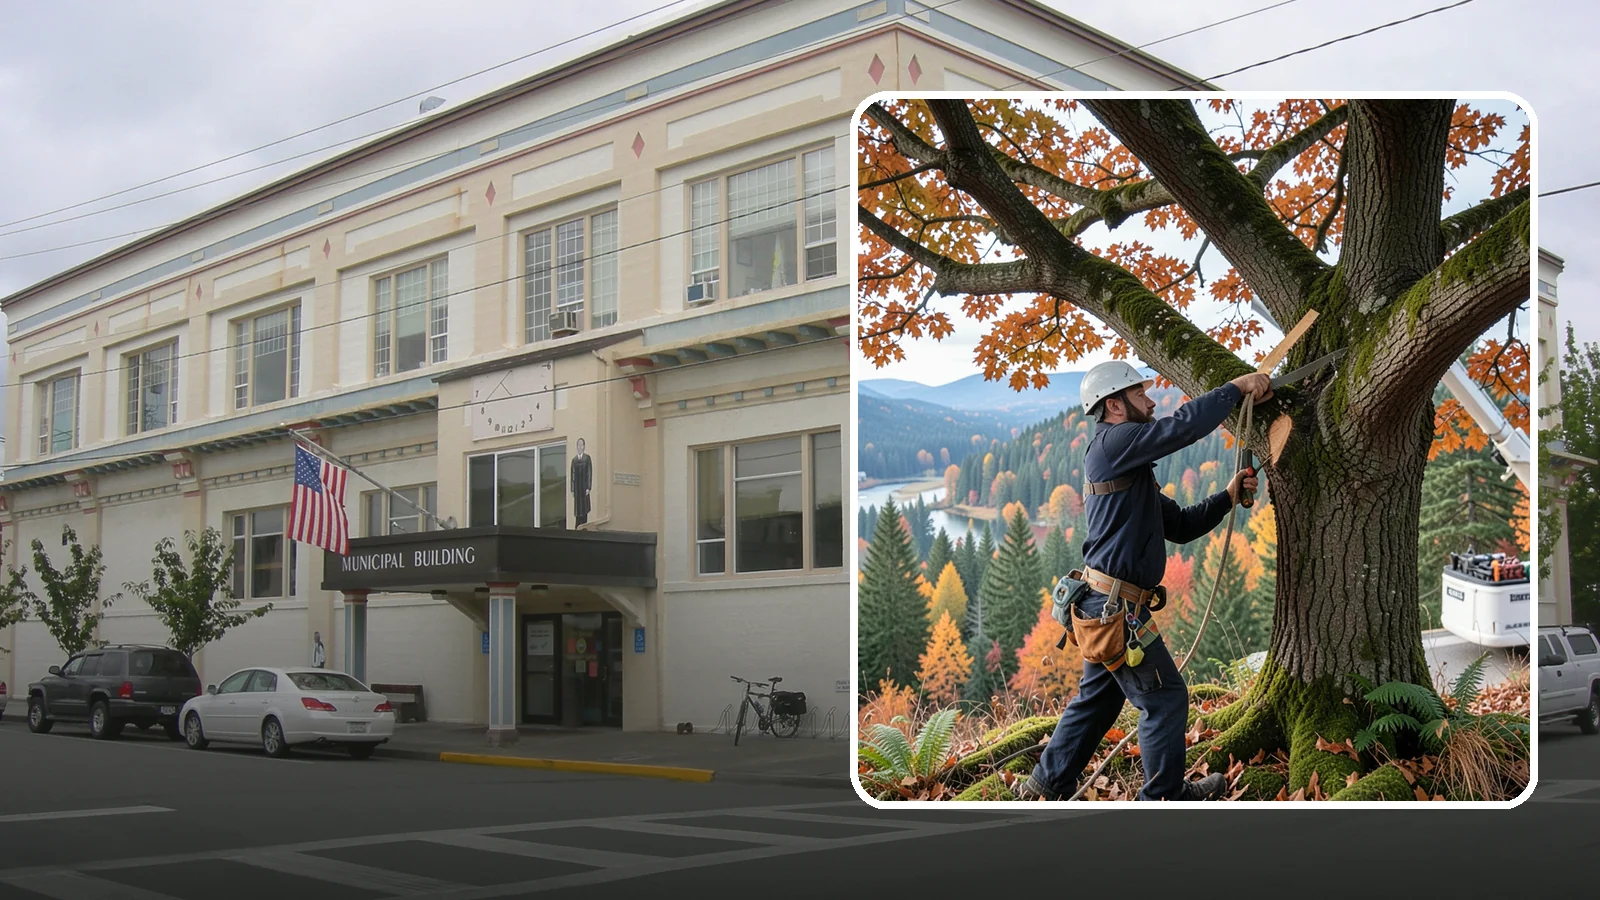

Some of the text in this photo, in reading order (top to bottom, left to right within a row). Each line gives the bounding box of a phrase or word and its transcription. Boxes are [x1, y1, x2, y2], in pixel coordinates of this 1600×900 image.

[481, 407, 485, 415] 8
[529, 414, 533, 422] 3
[495, 424, 500, 432] 10
[521, 420, 525, 428] 2
[508, 425, 513, 433] 12
[342, 546, 475, 572] MUNICIPAL BUILDING
